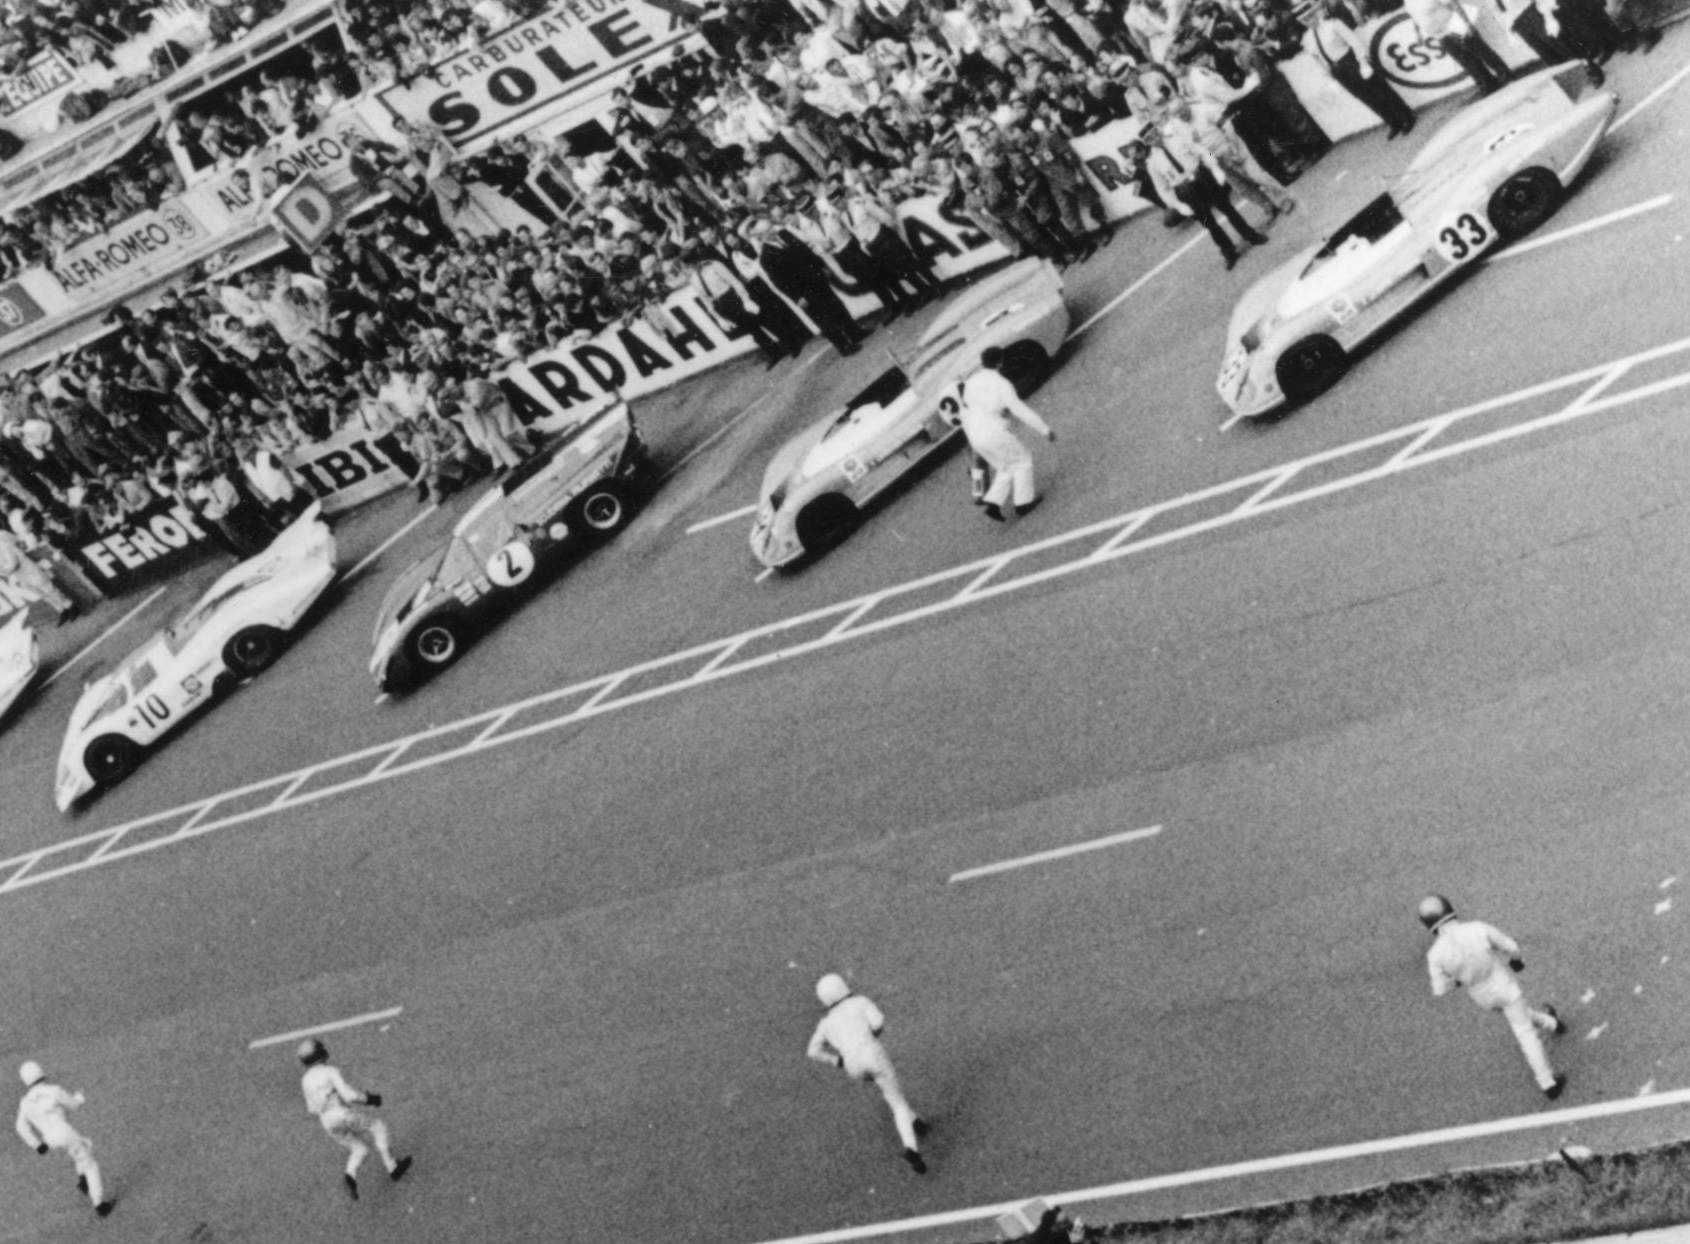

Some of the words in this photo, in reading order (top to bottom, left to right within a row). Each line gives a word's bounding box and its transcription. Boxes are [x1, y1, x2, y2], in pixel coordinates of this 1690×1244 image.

[434, 0, 614, 88] CARBURATEU
[166, 214, 193, 237] 38
[279, 186, 332, 242] D
[1439, 211, 1488, 260] 33
[496, 297, 753, 427] ARDAHL
[297, 440, 389, 497] IBI
[497, 549, 523, 578] 2
